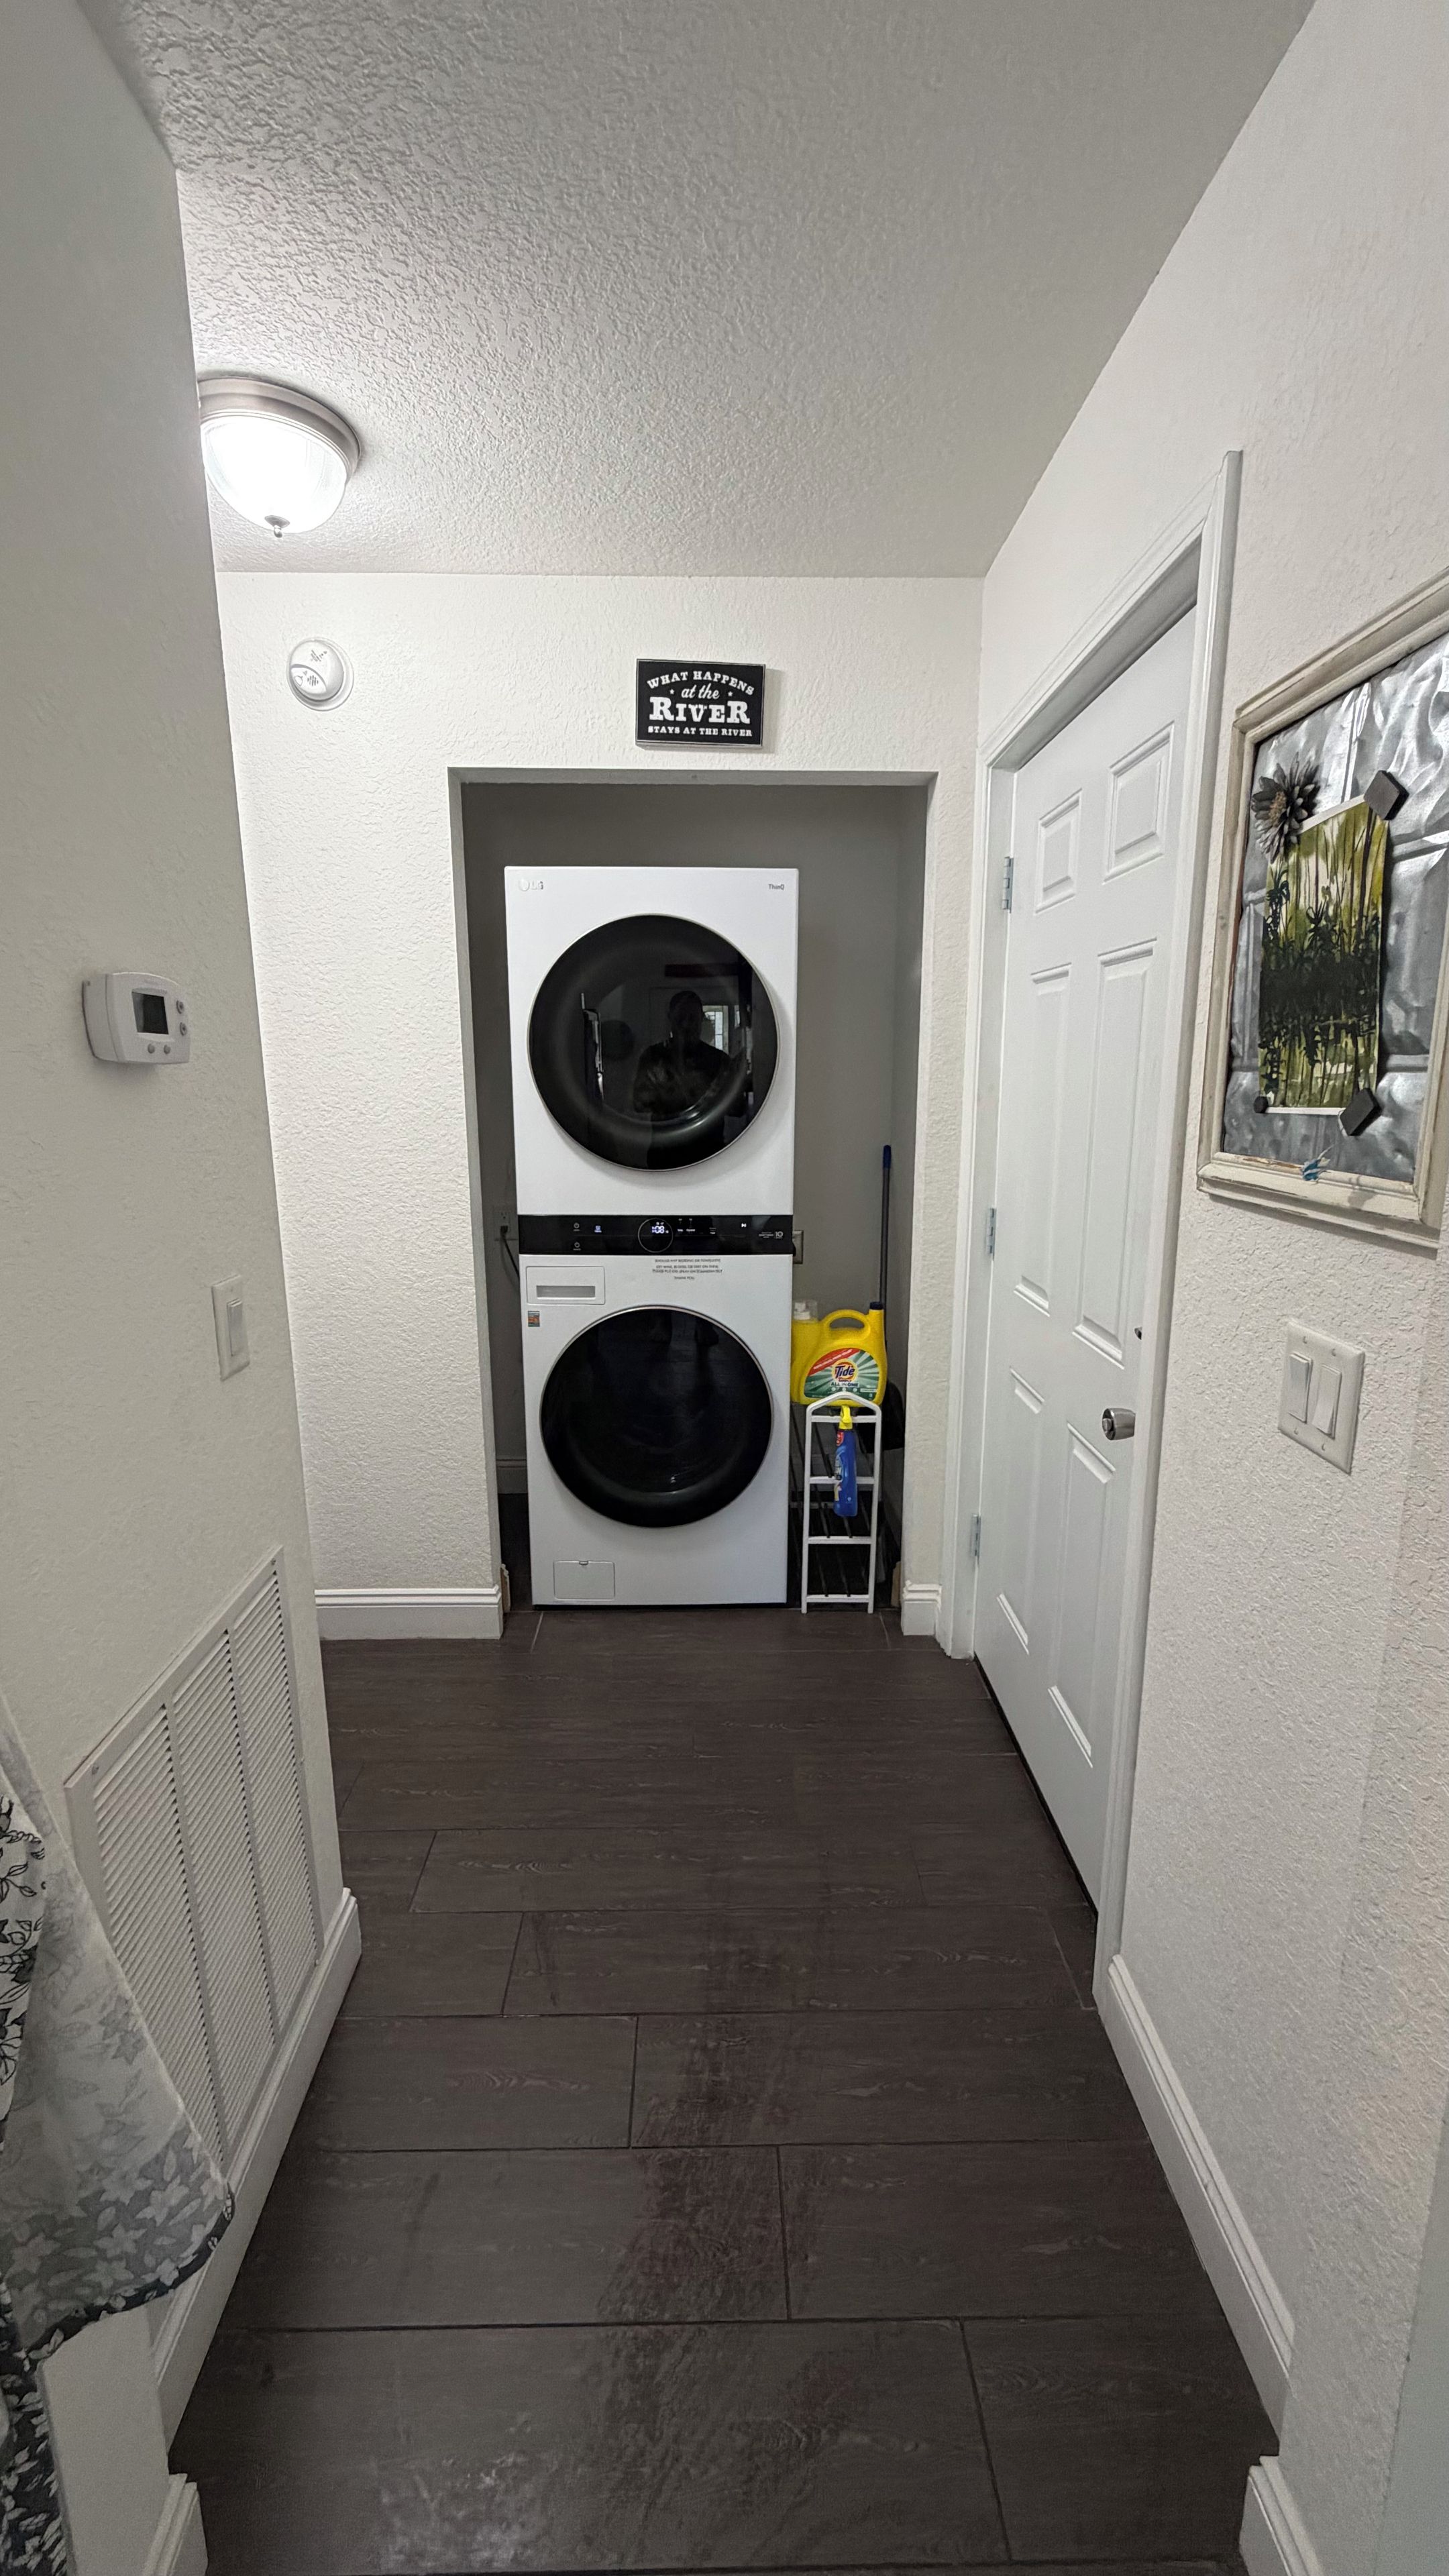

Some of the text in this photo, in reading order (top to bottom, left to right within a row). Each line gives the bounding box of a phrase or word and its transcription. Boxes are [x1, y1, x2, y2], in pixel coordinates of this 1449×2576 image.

[647, 671, 755, 696] WHAT HAPPENS
[681, 683, 720, 699] at the
[649, 696, 751, 724] RIVER
[647, 726, 680, 734] STAYS
[721, 729, 753, 737] RIVER
[835, 1365, 855, 1379] Tide
